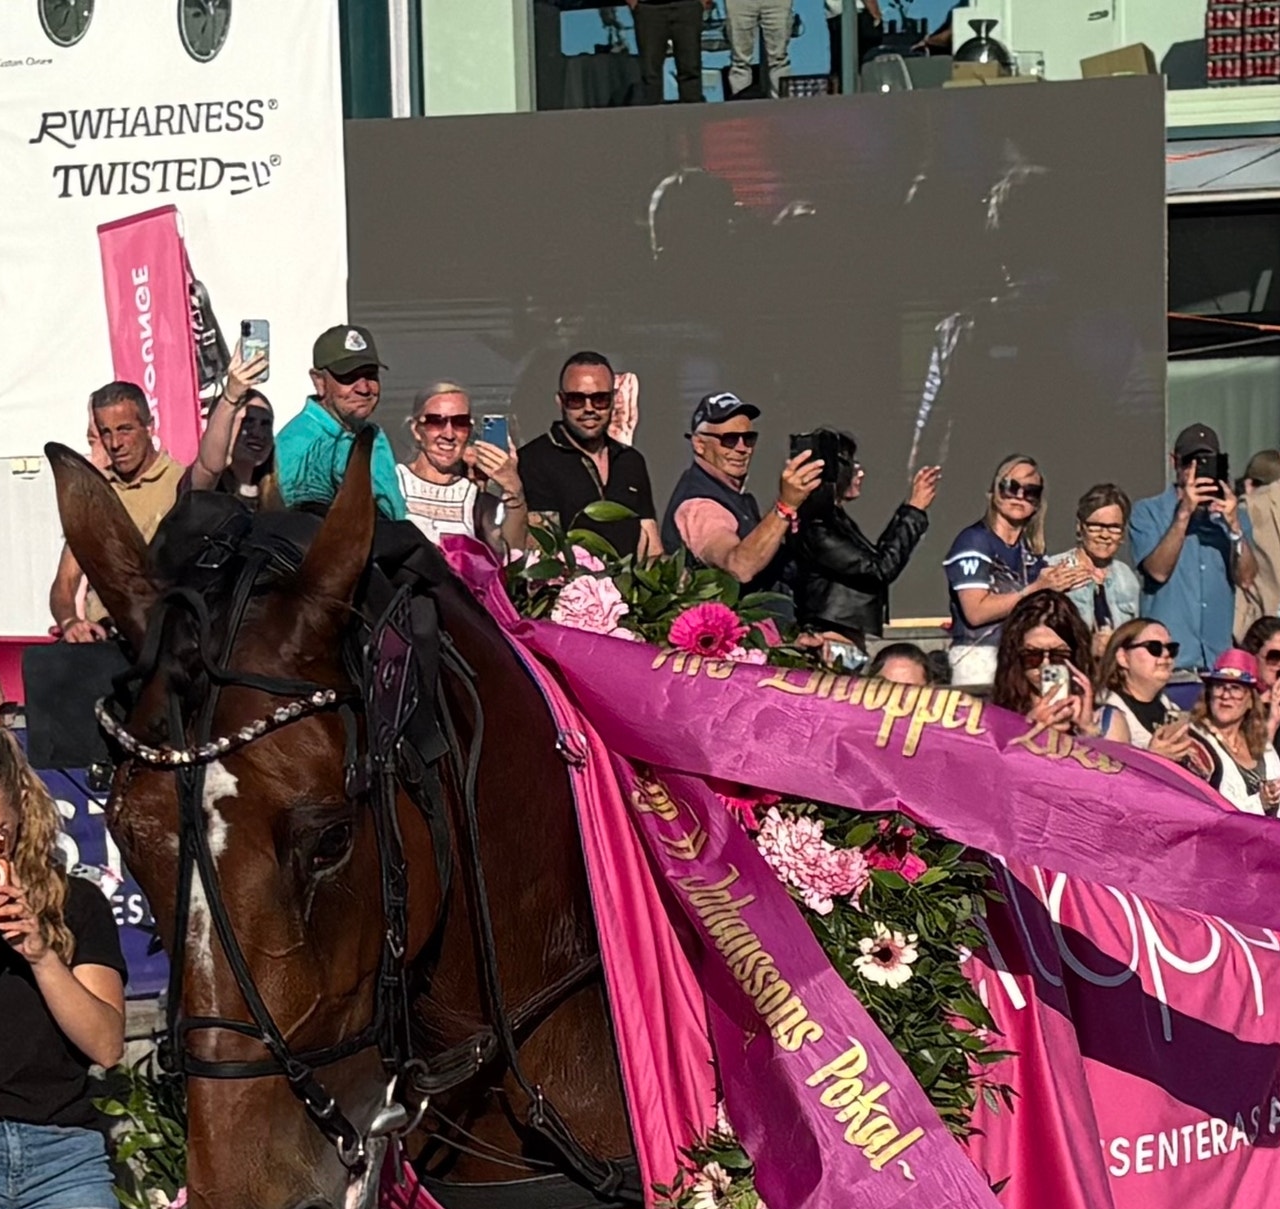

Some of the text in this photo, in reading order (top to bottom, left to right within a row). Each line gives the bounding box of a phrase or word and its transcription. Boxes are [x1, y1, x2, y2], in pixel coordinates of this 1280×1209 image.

[959, 558, 980, 576] W
[805, 1035, 925, 1173] Pokal
[1107, 1104, 1261, 1178] SENTERAS
